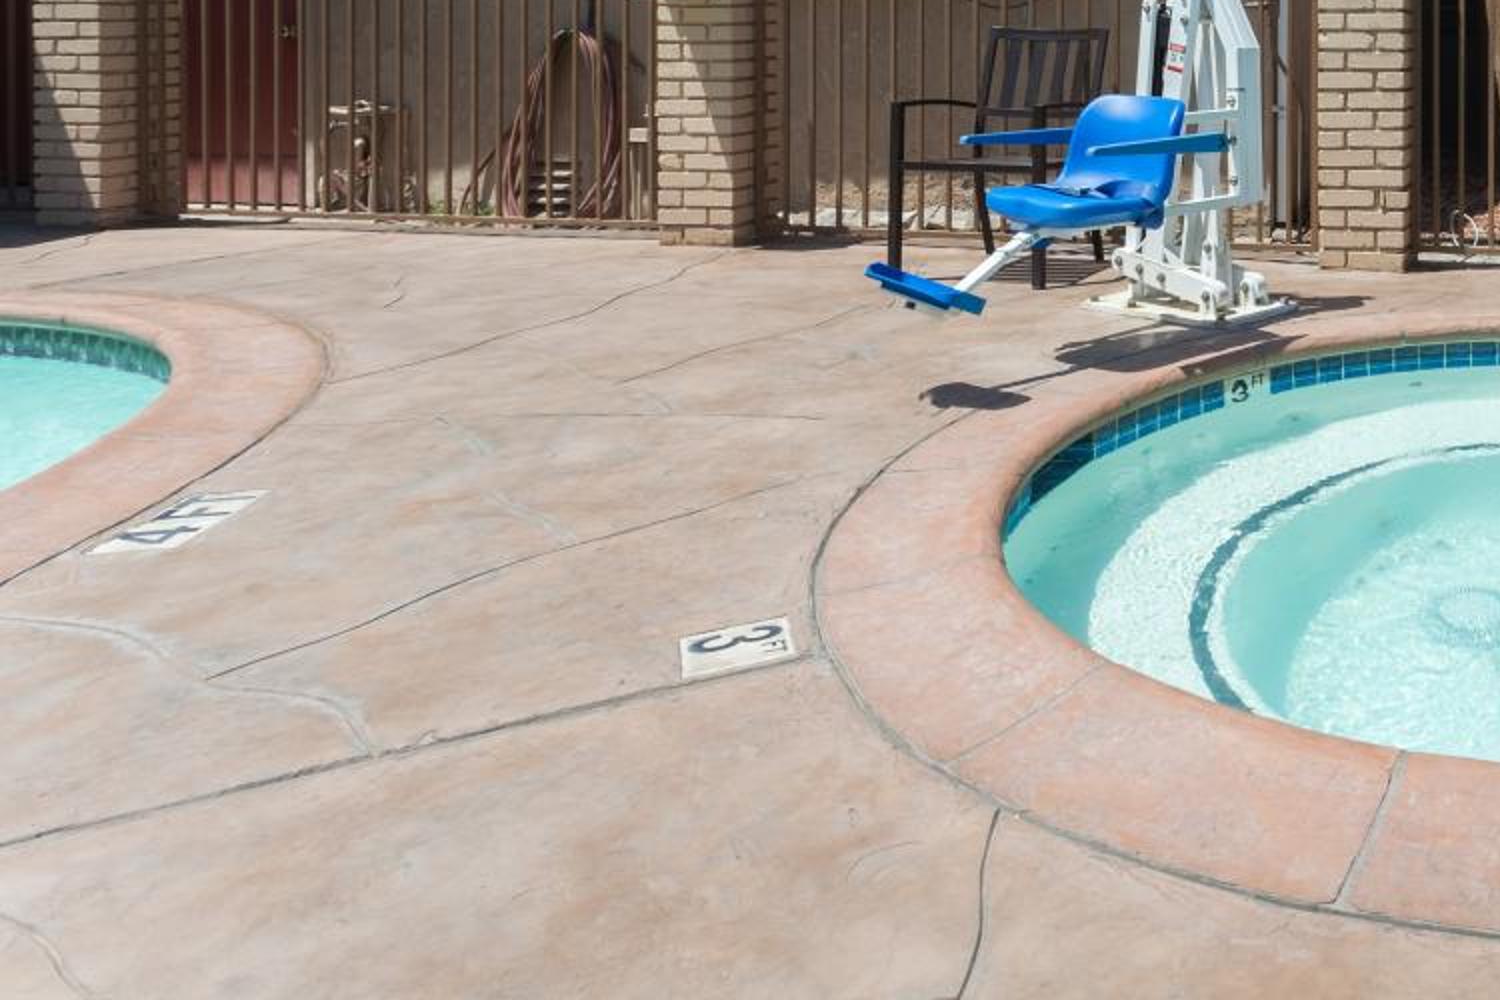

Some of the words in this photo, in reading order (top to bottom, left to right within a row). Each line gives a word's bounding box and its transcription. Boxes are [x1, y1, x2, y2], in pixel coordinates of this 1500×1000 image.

[1231, 379, 1249, 402] 3
[1251, 373, 1264, 389] FT
[114, 524, 201, 545] 4
[687, 625, 783, 653] 3
